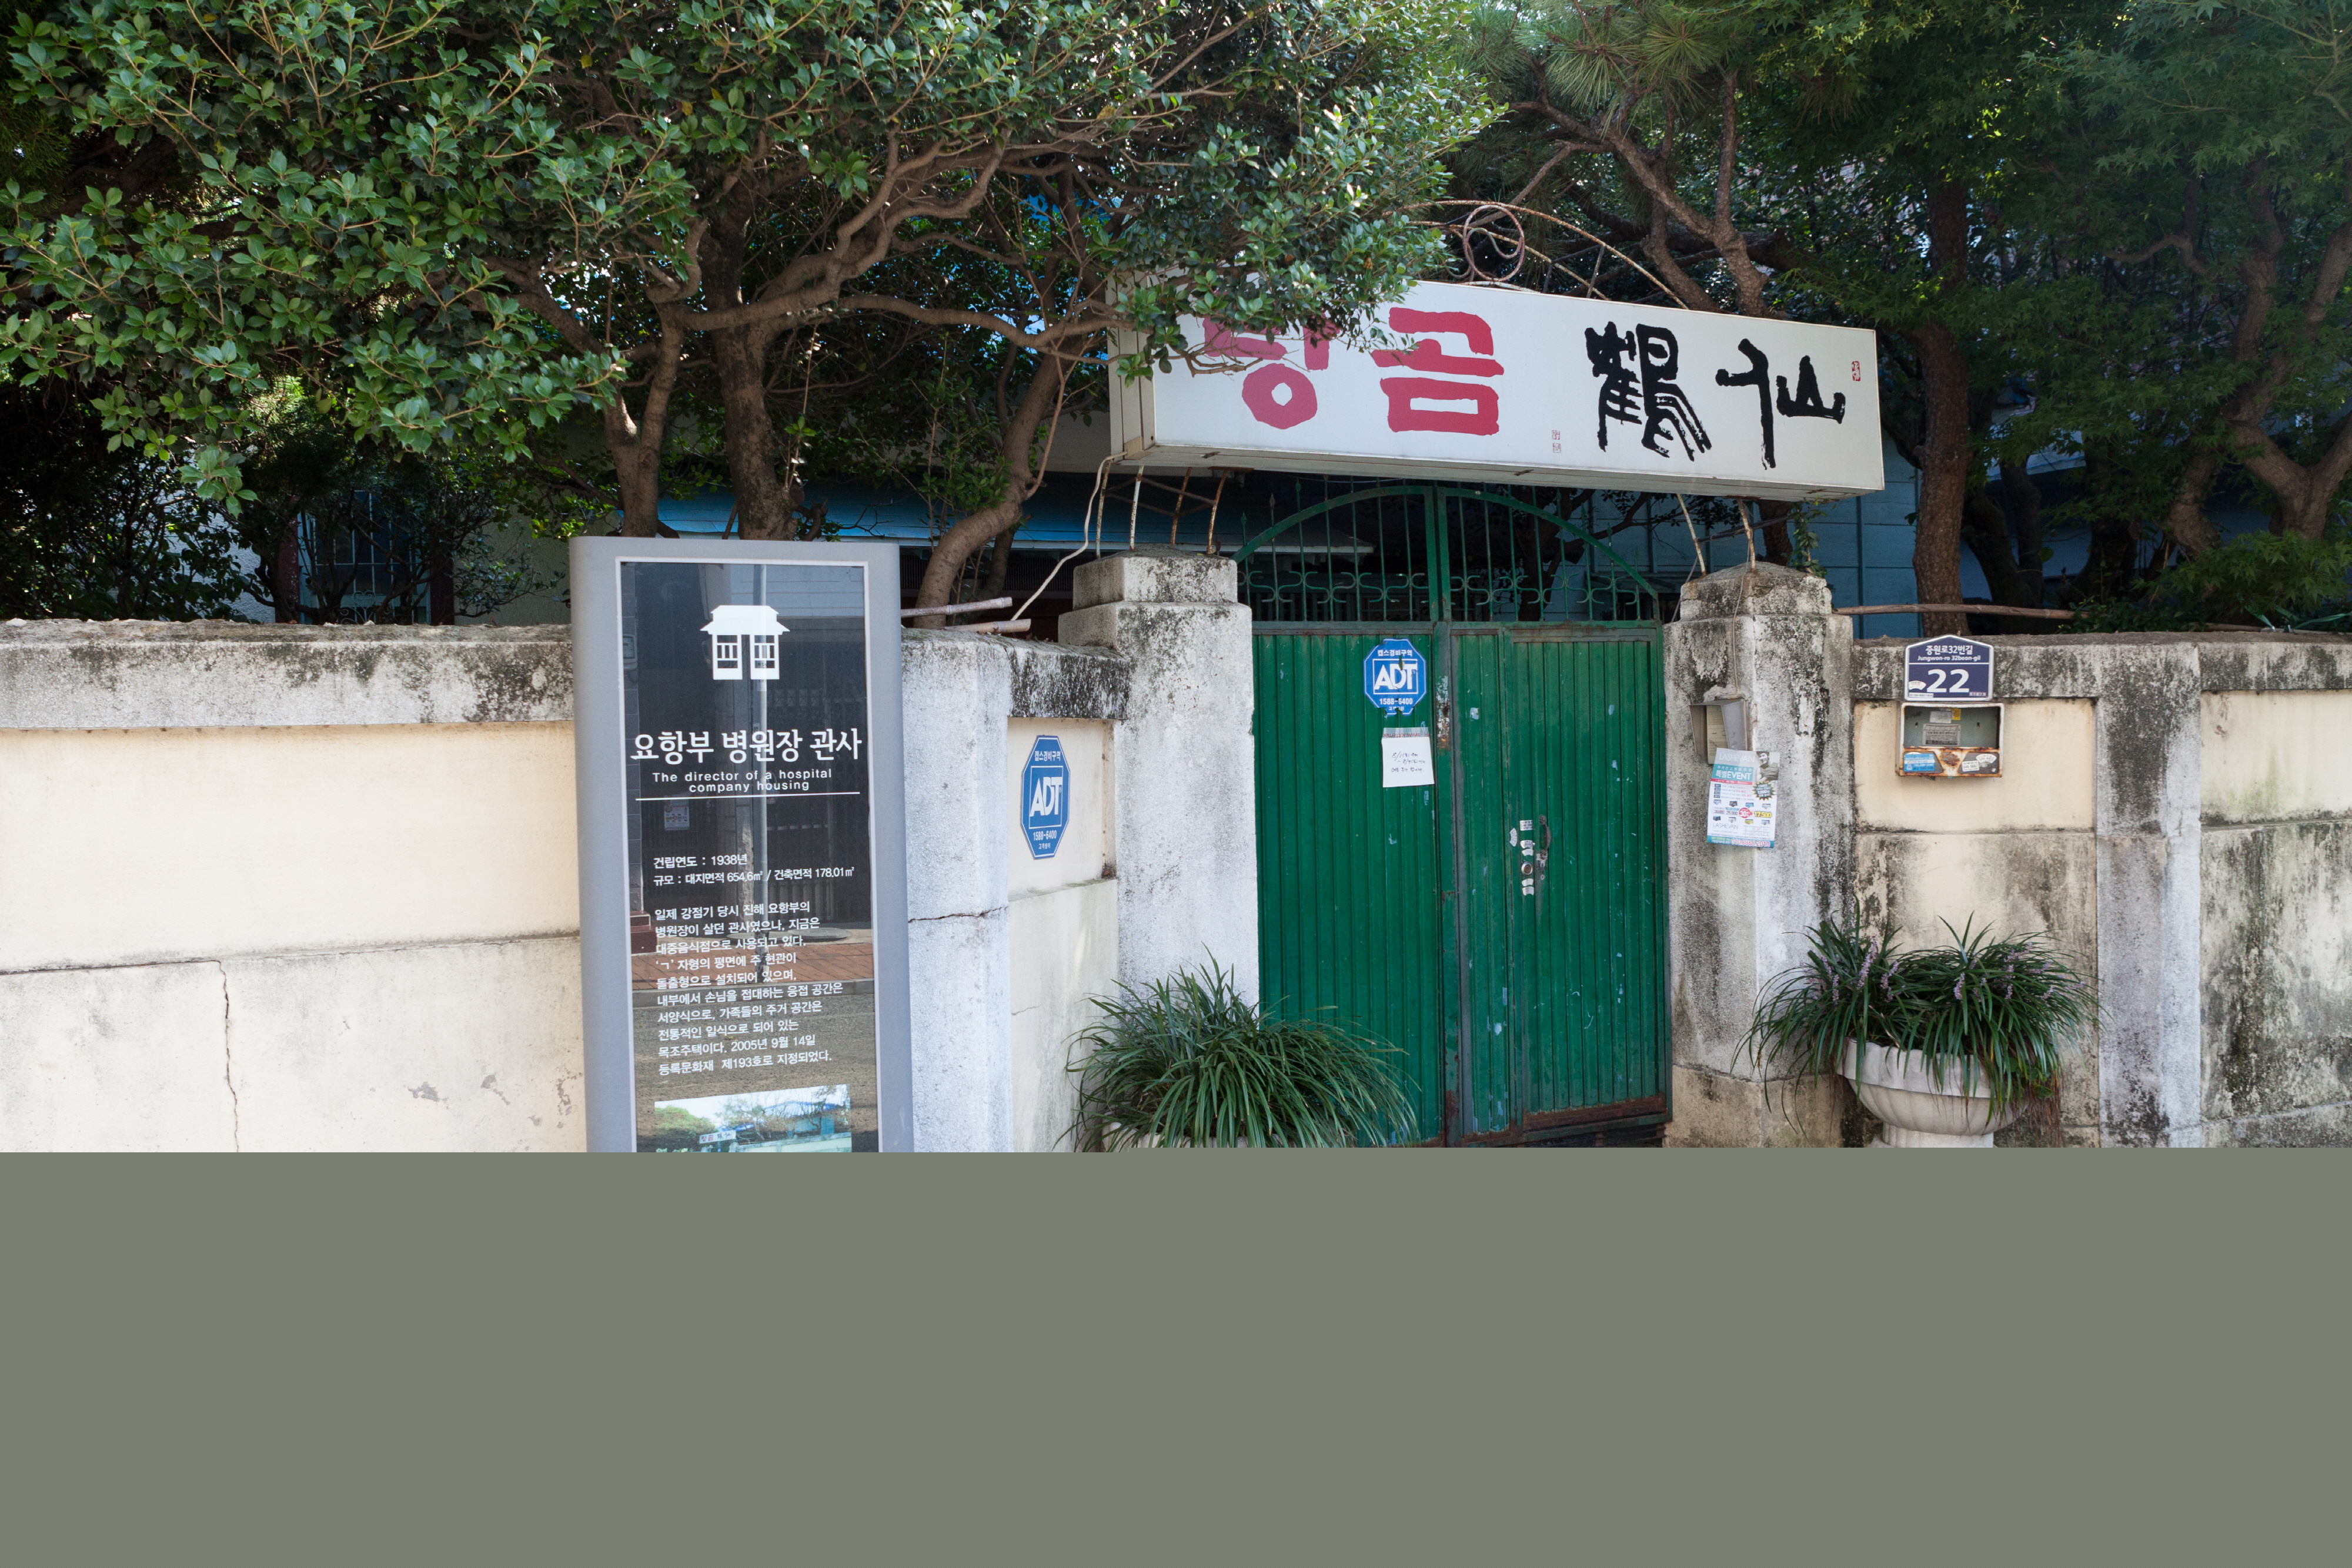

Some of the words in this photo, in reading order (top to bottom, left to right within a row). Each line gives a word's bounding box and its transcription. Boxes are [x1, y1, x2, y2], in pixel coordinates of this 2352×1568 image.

[1925, 645, 1973, 655] 중원로32번길
[1374, 663, 1418, 690] ADT
[1927, 668, 1969, 693] 22
[631, 732, 714, 764] 요항부
[721, 730, 803, 764] 병원장
[810, 728, 862, 761] 관사
[1719, 753, 1755, 762] LASHEVAN
[653, 772, 677, 782] The
[684, 771, 739, 781] director
[746, 770, 759, 780] of
[779, 768, 832, 781] hospital
[689, 782, 750, 793] company
[757, 781, 809, 792] housing
[1030, 777, 1063, 817] ADT
[1033, 830, 1057, 841] 1588-6400
[653, 857, 697, 869] 건립연도
[711, 854, 747, 867] 1938년
[653, 875, 674, 885] 규모
[686, 872, 724, 884] 대지면적
[774, 868, 812, 881] 건축면적
[655, 908, 677, 921] 일제
[681, 906, 713, 920] 강점기
[717, 905, 739, 917] 당시
[743, 903, 764, 917] 진해
[768, 901, 810, 916] 요항부의
[656, 924, 699, 938] 병원장이
[704, 923, 724, 936] 살던
[729, 920, 785, 934] 관사였으나,
[789, 917, 820, 930] 지금은
[656, 940, 731, 955] 대중음식점으로
[737, 937, 778, 950] 사용되고
[782, 935, 806, 948] 있다.
[678, 958, 710, 969] 자형의
[714, 955, 746, 968] 평면에
[751, 955, 761, 965] 주
[765, 952, 796, 965] 현관이
[657, 976, 711, 989] 돌출형으로
[715, 973, 758, 986] 설치되어
[763, 969, 797, 983] 있으며,
[658, 992, 700, 1007] 내부에서
[705, 989, 737, 1004] 손님을
[741, 987, 783, 1001] 접대하는
[787, 985, 807, 998] 응접
[811, 982, 843, 995] 공간은
[658, 1009, 715, 1024] 서양식으로,
[720, 1005, 762, 1020] 가족들의
[766, 1003, 786, 1016] 주거
[791, 1000, 822, 1013] 공간은
[659, 1027, 701, 1041] 전통적인
[706, 1023, 747, 1037] 일식으로
[753, 1021, 774, 1034] 되어
[778, 1019, 799, 1032] 있는
[659, 1043, 727, 1058] 목조주택이다.
[731, 1039, 767, 1052] 2005년
[771, 1037, 789, 1049] 9월
[793, 1035, 816, 1048] 14일
[659, 1060, 713, 1075] 등록문화재
[721, 1056, 773, 1069] 제193호로
[777, 1051, 832, 1066] 지정되었다.
